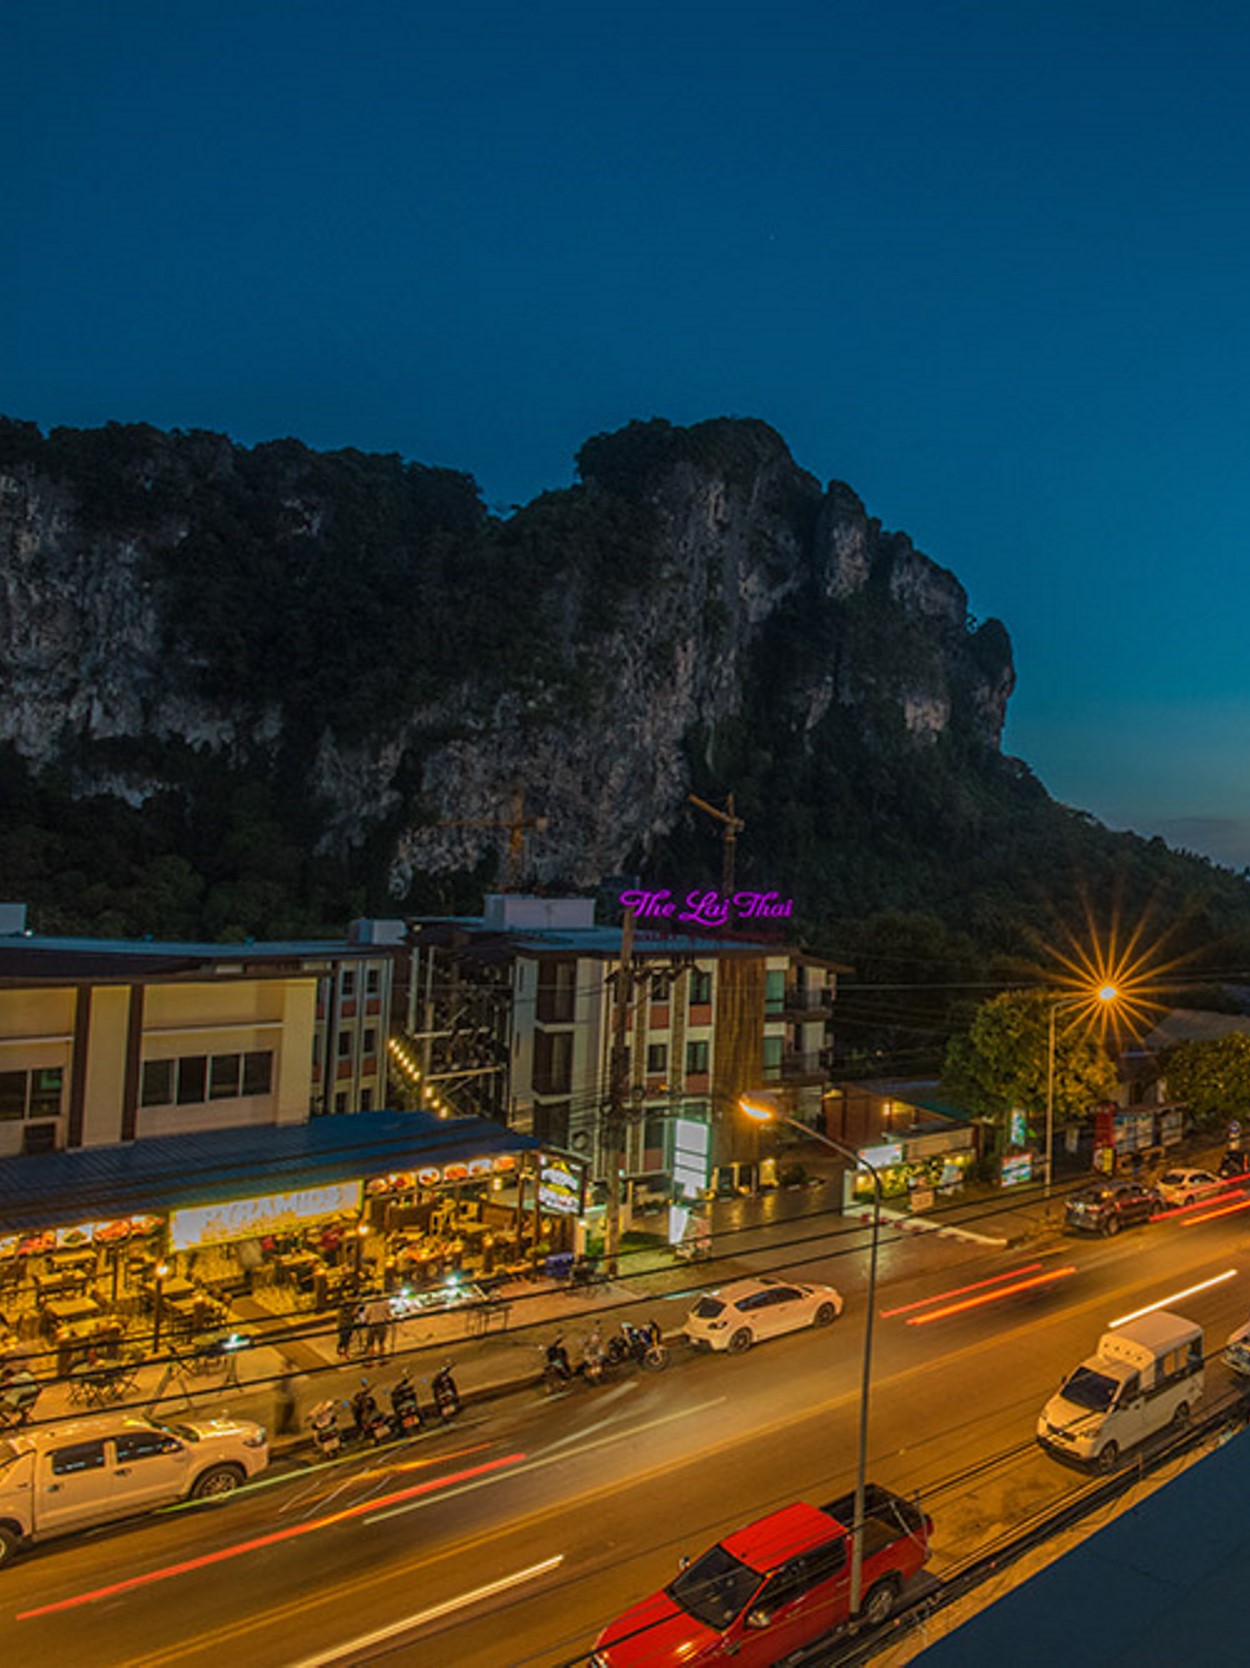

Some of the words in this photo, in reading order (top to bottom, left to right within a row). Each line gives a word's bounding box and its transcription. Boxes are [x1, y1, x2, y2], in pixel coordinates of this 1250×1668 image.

[618, 888, 677, 918] The
[677, 889, 731, 927] Lai
[732, 890, 793, 918] Thai
